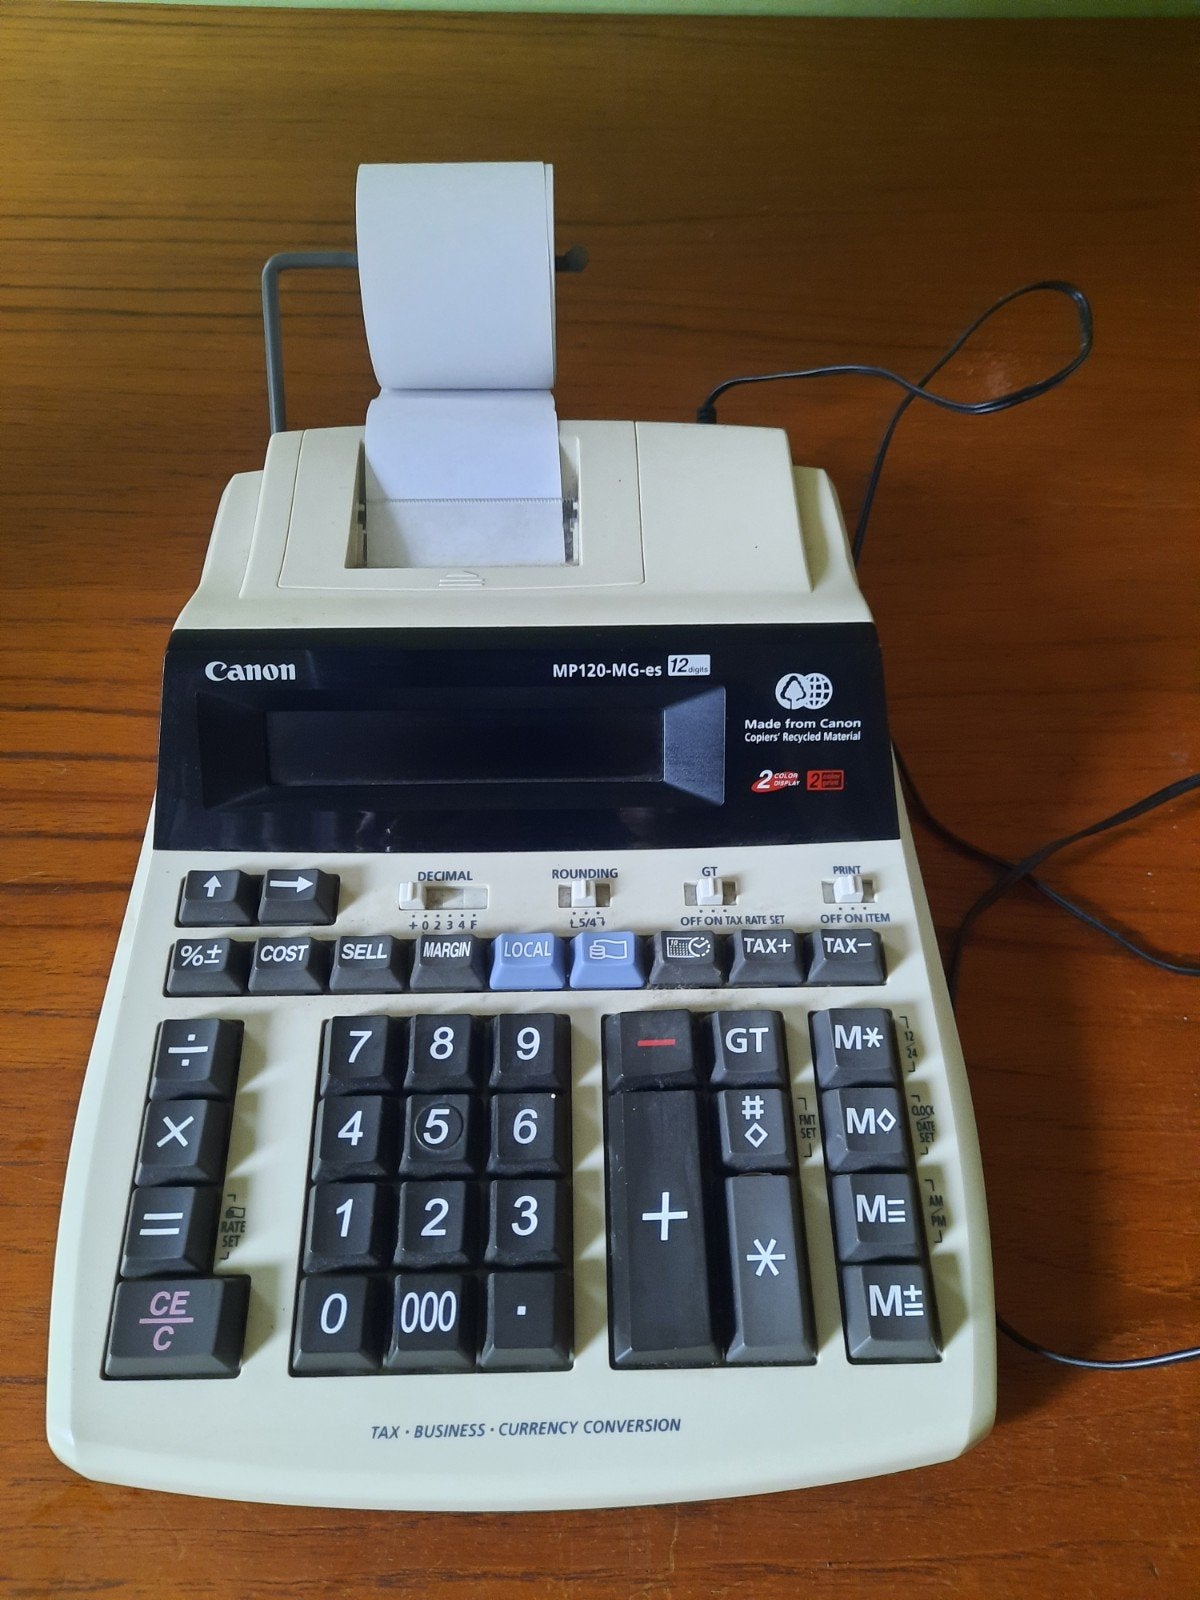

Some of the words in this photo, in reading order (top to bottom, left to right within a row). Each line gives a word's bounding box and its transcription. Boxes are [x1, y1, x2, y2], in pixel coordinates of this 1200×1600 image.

[204, 661, 296, 681] Canon
[553, 663, 662, 678] MP120-MG-es
[669, 657, 689, 674] 12
[688, 665, 709, 675] digits
[744, 719, 781, 729] Made
[785, 719, 815, 729] from
[820, 719, 861, 729] Canon
[744, 732, 780, 743] Copiers'
[783, 731, 821, 743] Recycled
[823, 730, 861, 742] Material
[756, 769, 773, 789] 2
[417, 871, 473, 882] DECIMAL
[552, 868, 618, 879] ROUNDING
[702, 866, 718, 877] GT
[833, 865, 861, 875] PRINT
[422, 920, 429, 931] 0
[434, 920, 441, 931] 2
[446, 920, 453, 931] 3
[458, 920, 465, 931] 4
[471, 920, 478, 930] F
[680, 915, 703, 926] OFF
[704, 915, 723, 926] ON
[725, 915, 743, 925] TAX
[745, 915, 767, 925] RATE
[769, 914, 785, 925] SET
[820, 913, 842, 924] OFF
[844, 913, 863, 923] ON
[865, 912, 890, 923] ITEM
[260, 944, 309, 962] COST
[341, 943, 388, 960] SELL
[423, 941, 471, 958] MARGIN
[504, 941, 551, 958] LOCAL
[744, 937, 792, 954] TAX+
[347, 1030, 372, 1063] 7
[429, 1026, 454, 1060] 8
[516, 1026, 541, 1060] 9
[725, 1027, 769, 1053] GT
[911, 1105, 935, 1116] CLOCK
[337, 1110, 363, 1146] 4
[422, 1108, 450, 1144] 5
[512, 1108, 538, 1144] 6
[800, 1127, 816, 1139] SET
[916, 1121, 935, 1131] DATE
[920, 1132, 935, 1142] SET
[335, 1199, 354, 1237] 1
[420, 1198, 449, 1237] 2
[511, 1195, 538, 1236] 3
[220, 1221, 246, 1233] RATE
[222, 1235, 240, 1247] SET
[150, 1290, 190, 1316] CE
[400, 1290, 457, 1333] 000
[320, 1293, 347, 1334] 0
[153, 1325, 175, 1351] C
[371, 1426, 400, 1439] TAX
[414, 1423, 486, 1438] BUSINESS
[499, 1421, 578, 1436] CURRENCY
[583, 1418, 681, 1434] CONVERSION
